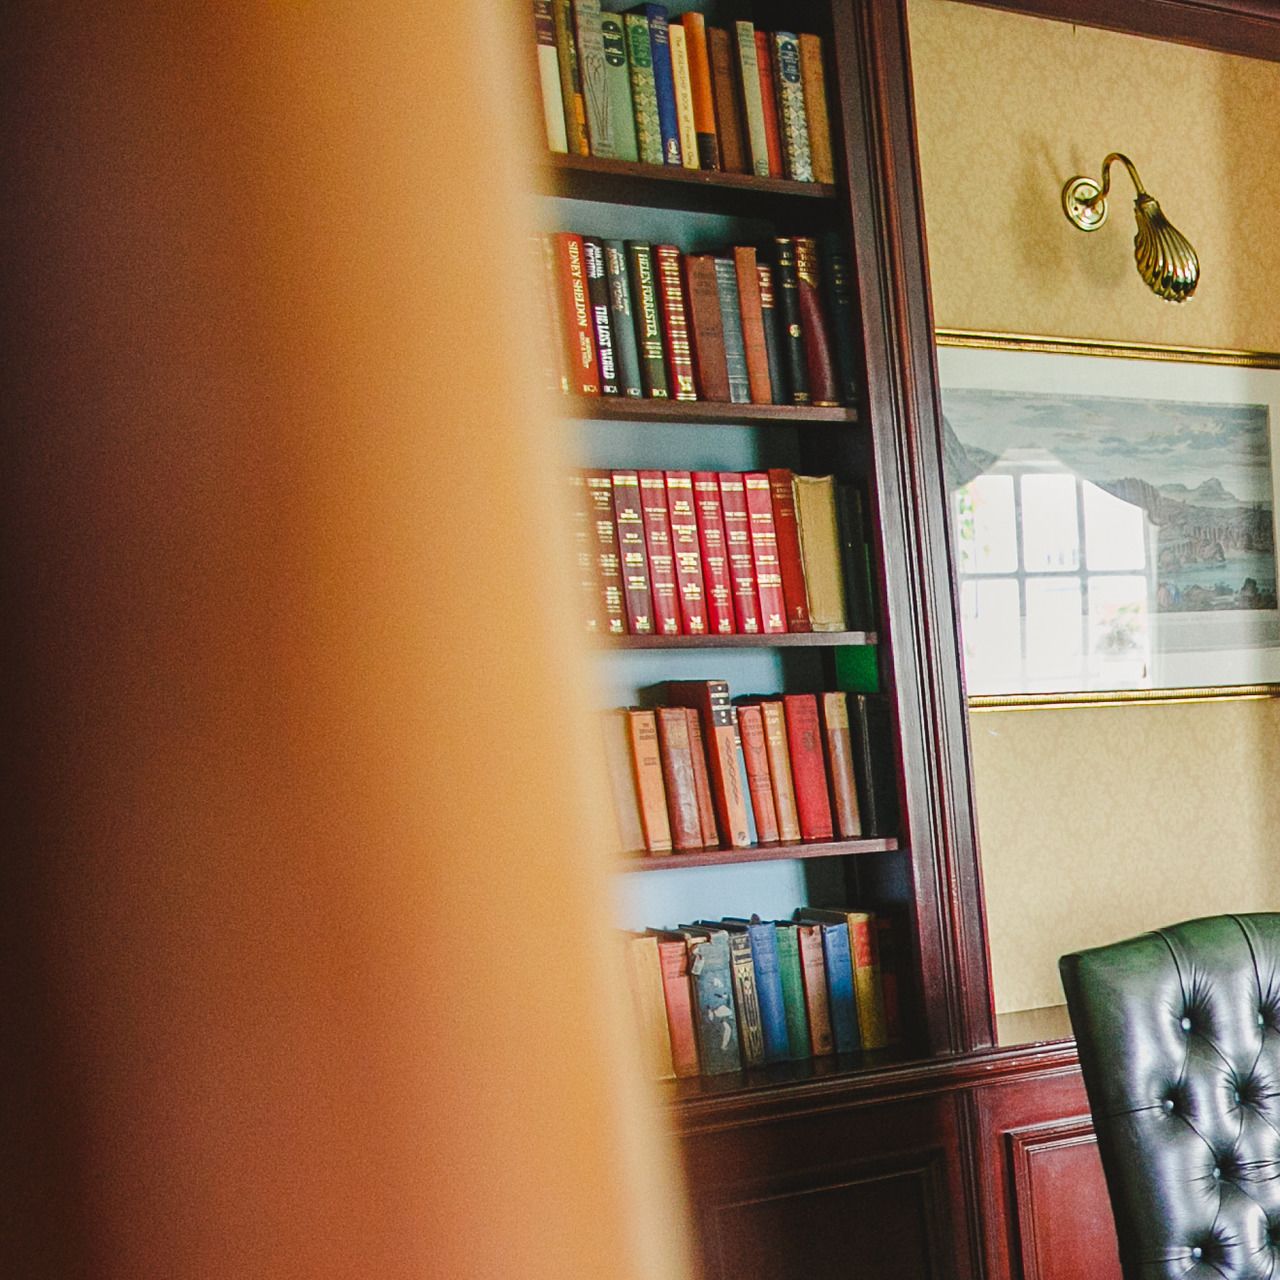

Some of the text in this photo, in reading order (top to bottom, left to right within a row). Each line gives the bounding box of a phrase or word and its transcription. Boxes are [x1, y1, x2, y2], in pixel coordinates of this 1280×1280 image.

[568, 241, 588, 327] SIDNEY SHELDON
[637, 253, 658, 338] HELEN FORRESTER
[597, 325, 612, 348] LOST
[600, 349, 615, 379] WORLD
